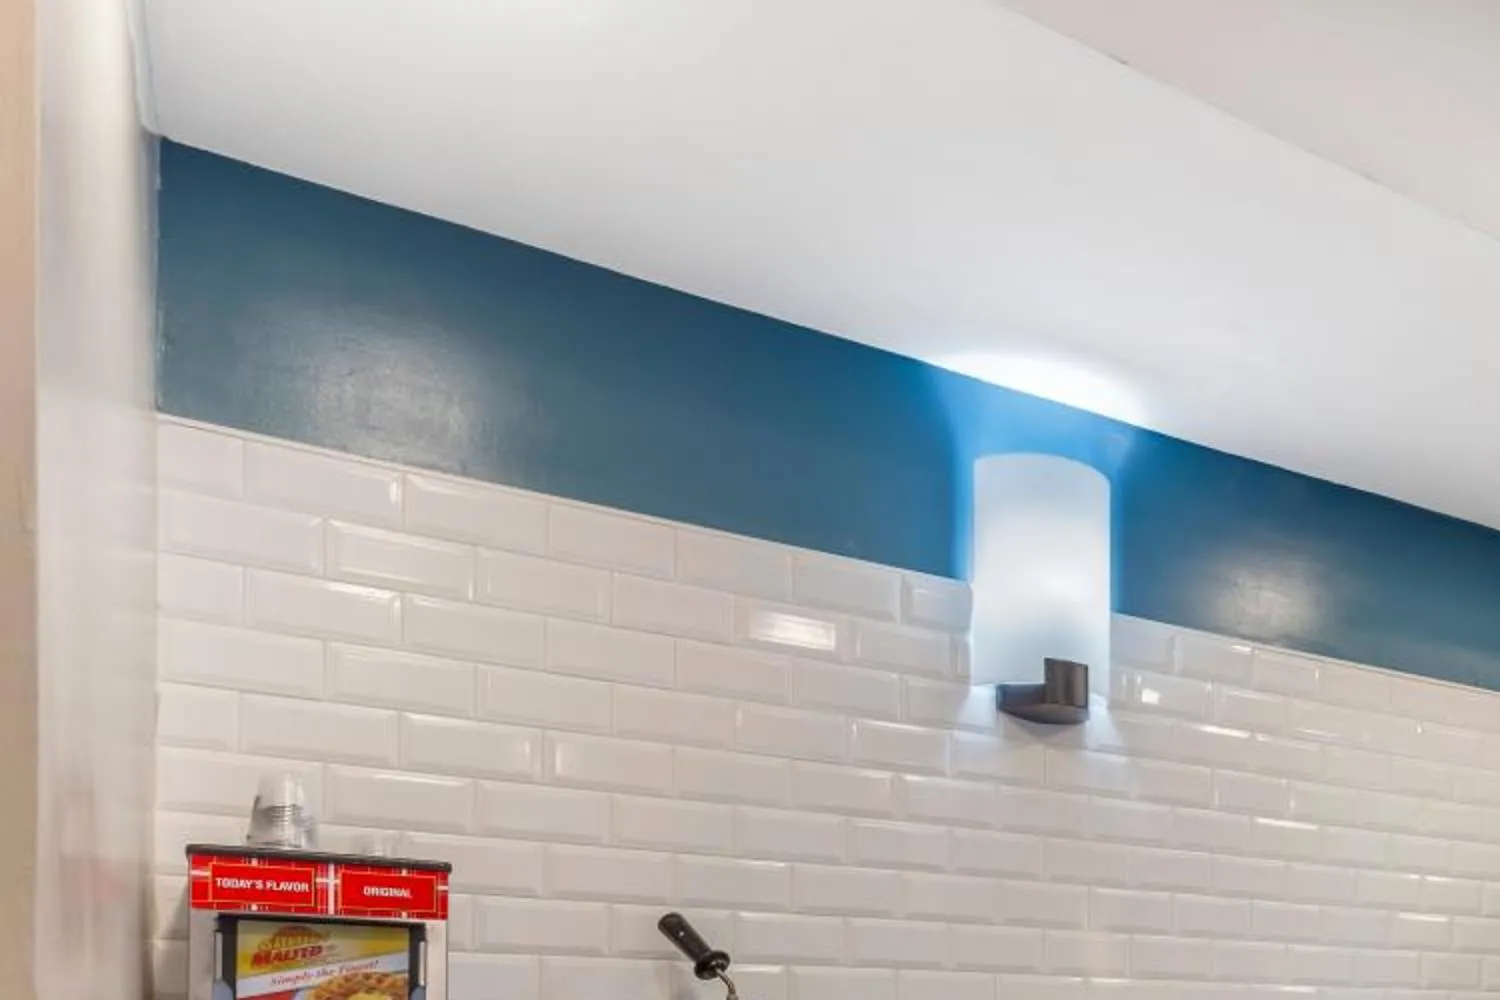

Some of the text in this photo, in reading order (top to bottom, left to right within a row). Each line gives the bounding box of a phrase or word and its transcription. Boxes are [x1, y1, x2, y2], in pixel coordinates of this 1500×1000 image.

[215, 877, 310, 893] TODAY'S FLAVOR
[363, 886, 413, 899] ORIGINAL
